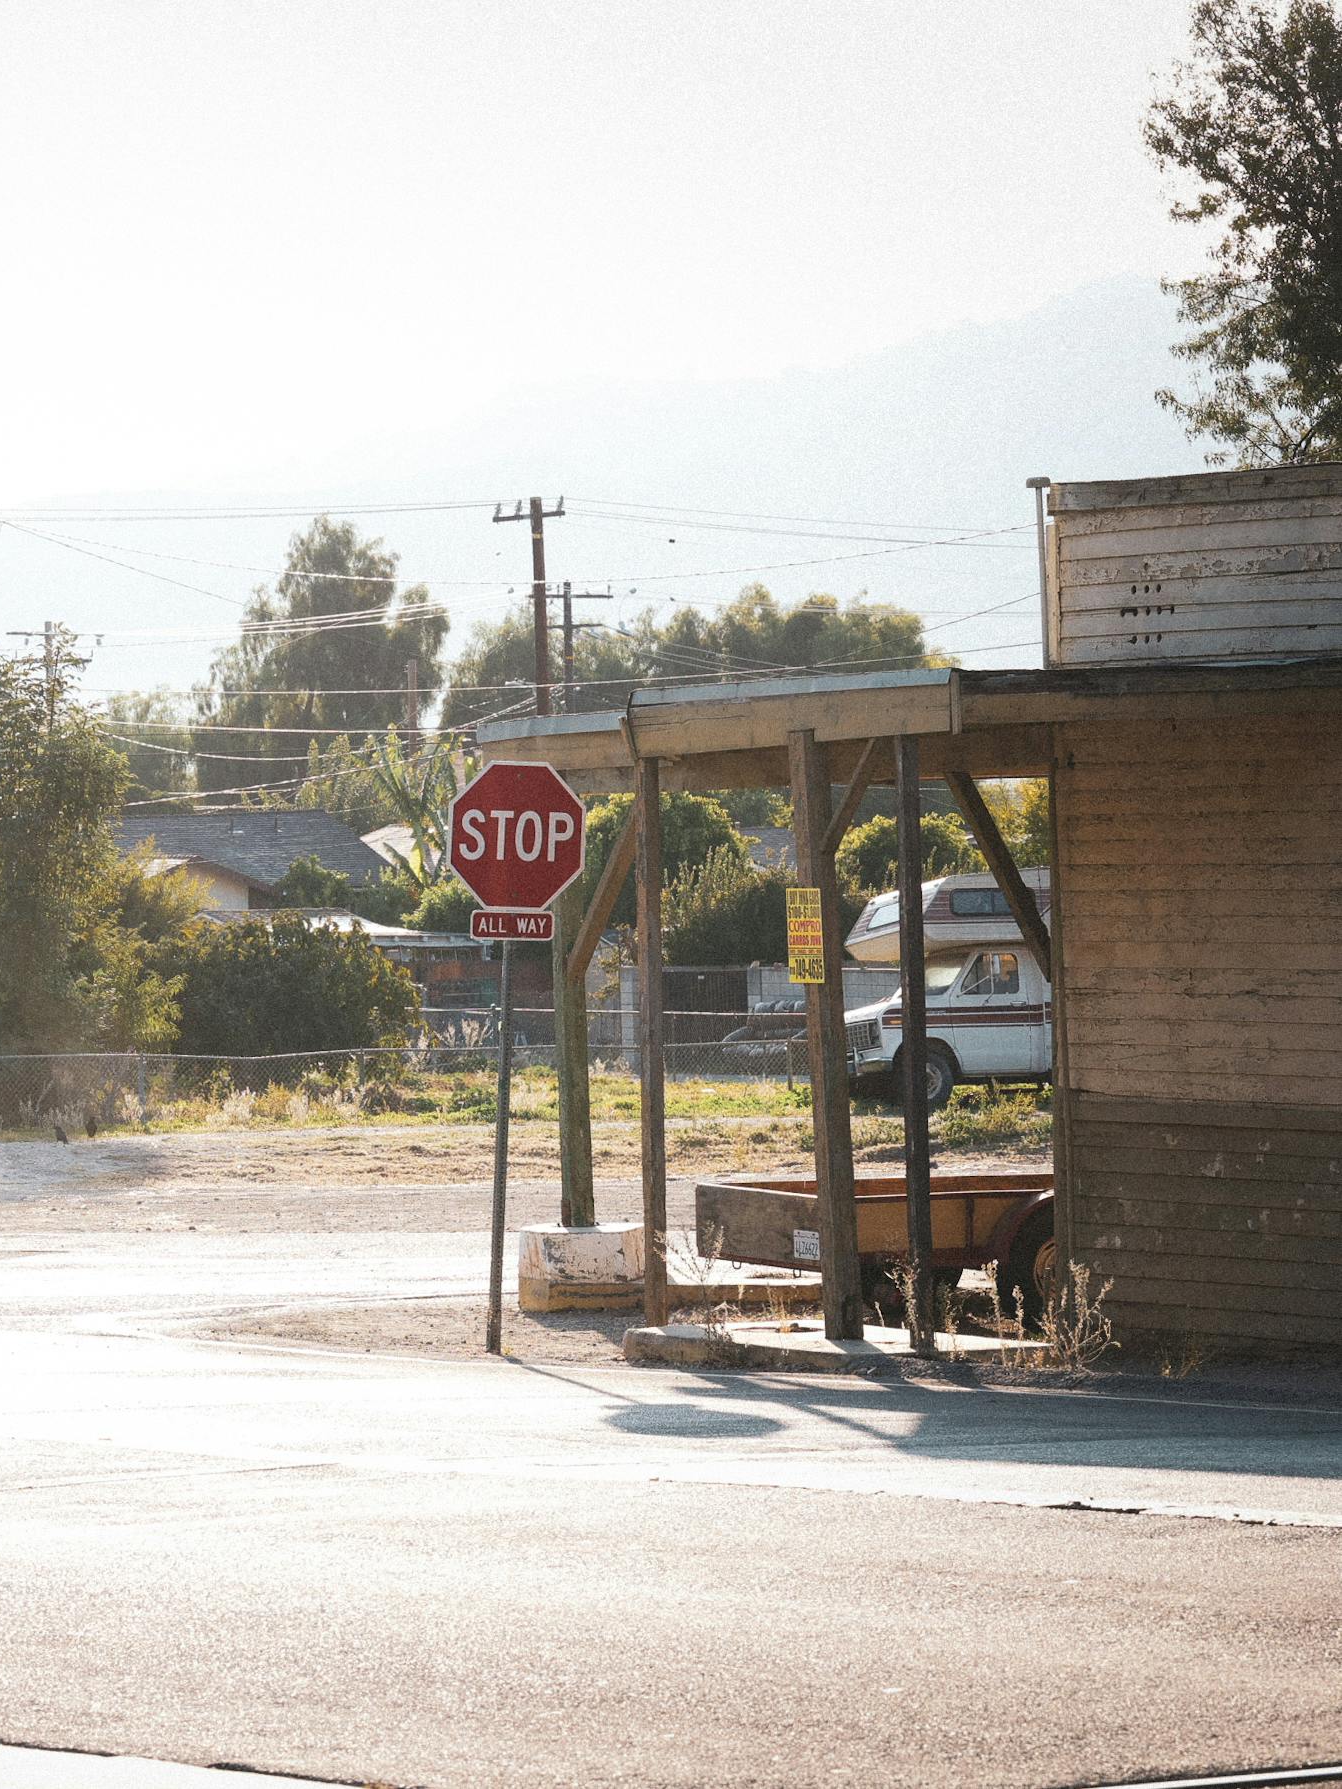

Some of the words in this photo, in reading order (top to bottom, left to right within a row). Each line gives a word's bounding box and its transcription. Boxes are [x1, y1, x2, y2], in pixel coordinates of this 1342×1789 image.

[459, 809, 575, 863] STOP
[478, 918, 507, 933] ALL
[517, 918, 547, 934] WAY
[789, 920, 821, 933] COMPRO
